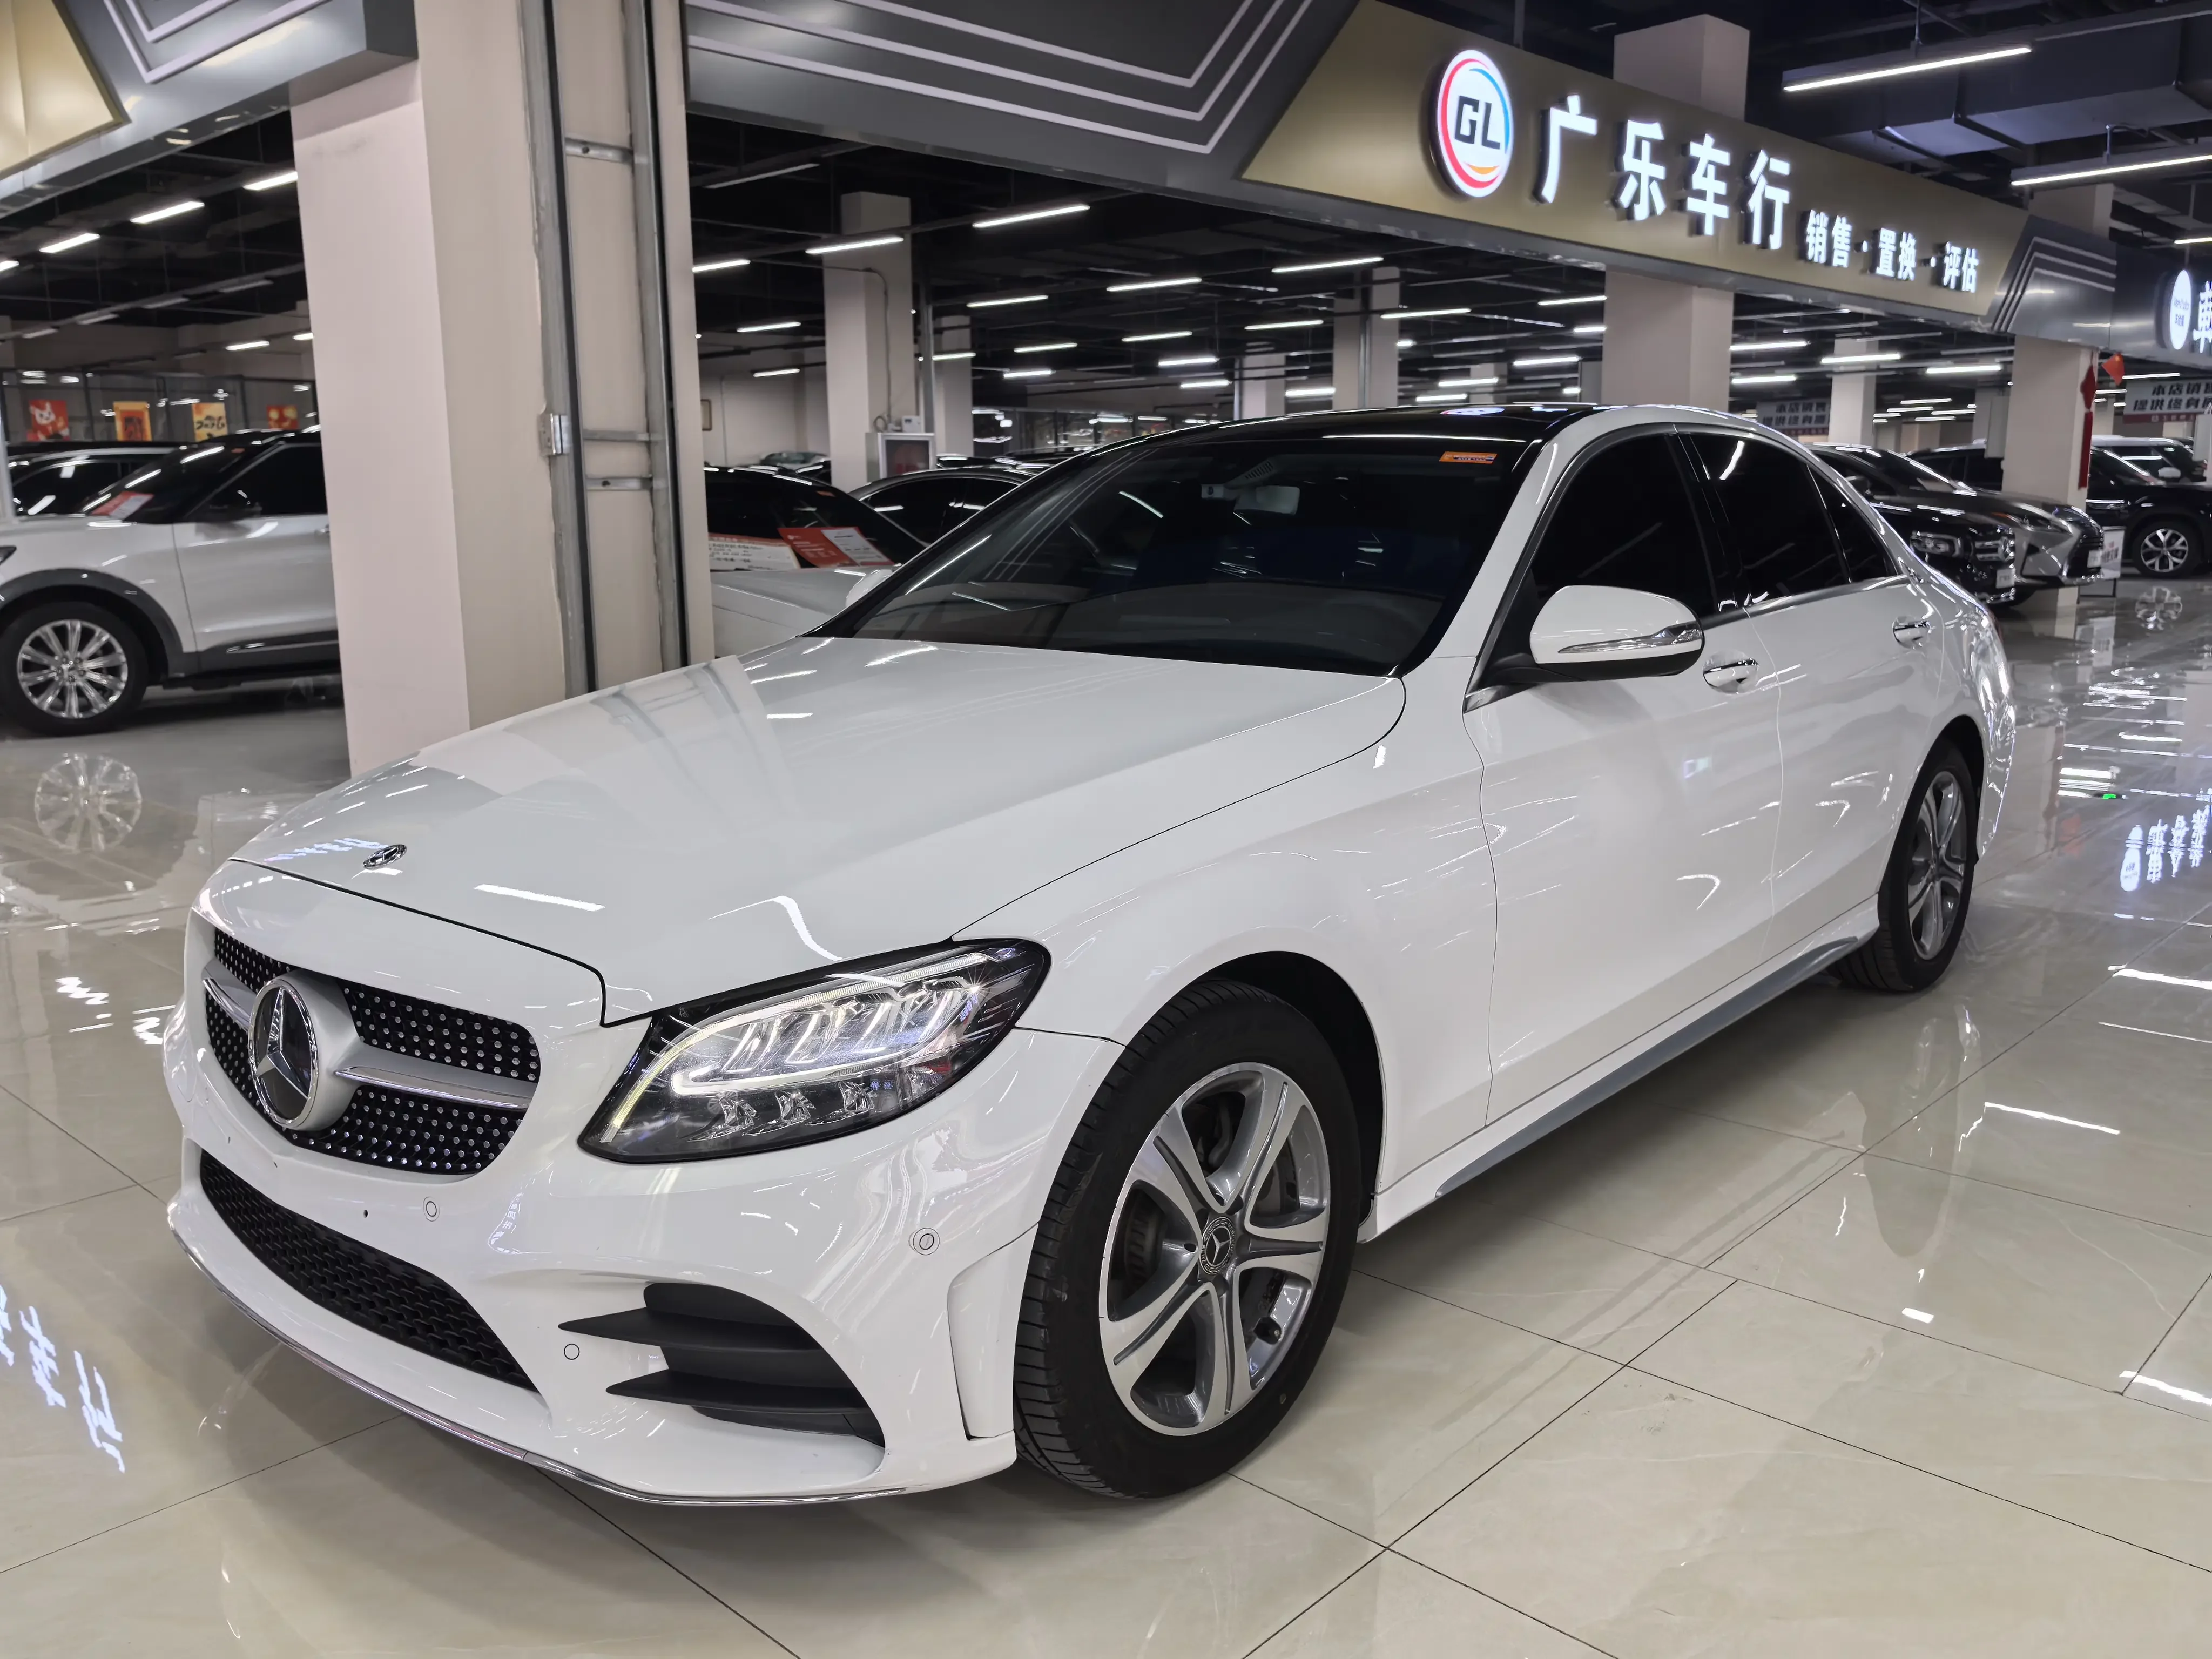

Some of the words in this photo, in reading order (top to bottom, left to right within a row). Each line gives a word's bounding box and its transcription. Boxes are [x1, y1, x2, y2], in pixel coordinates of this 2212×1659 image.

[1454, 96, 1501, 149] GL
[1540, 94, 1790, 250] 广乐车行
